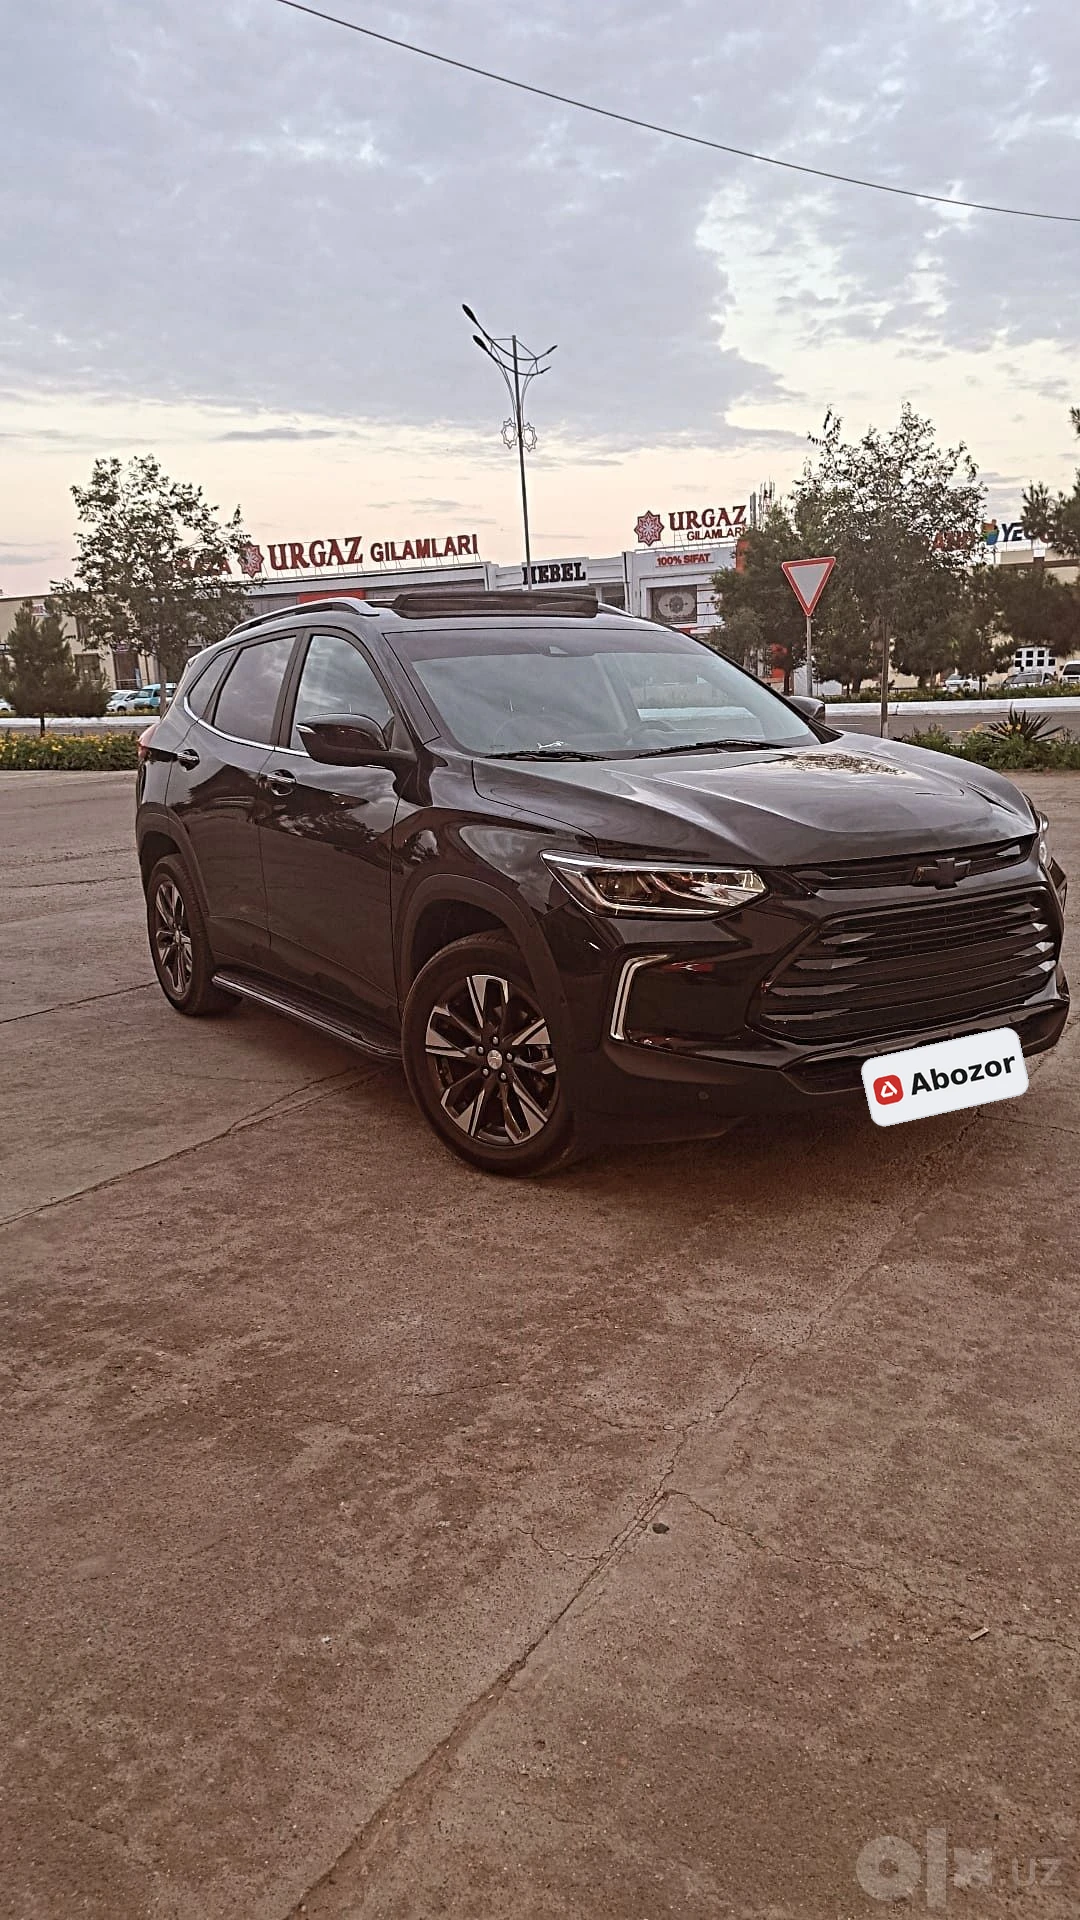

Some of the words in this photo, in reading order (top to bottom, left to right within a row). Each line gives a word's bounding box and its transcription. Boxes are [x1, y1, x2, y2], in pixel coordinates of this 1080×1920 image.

[668, 505, 747, 531] URGAZ
[267, 536, 364, 571] URGAZ
[370, 533, 479, 563] GILAMLARI
[657, 556, 682, 566] 100%
[683, 553, 711, 564] SIFAT
